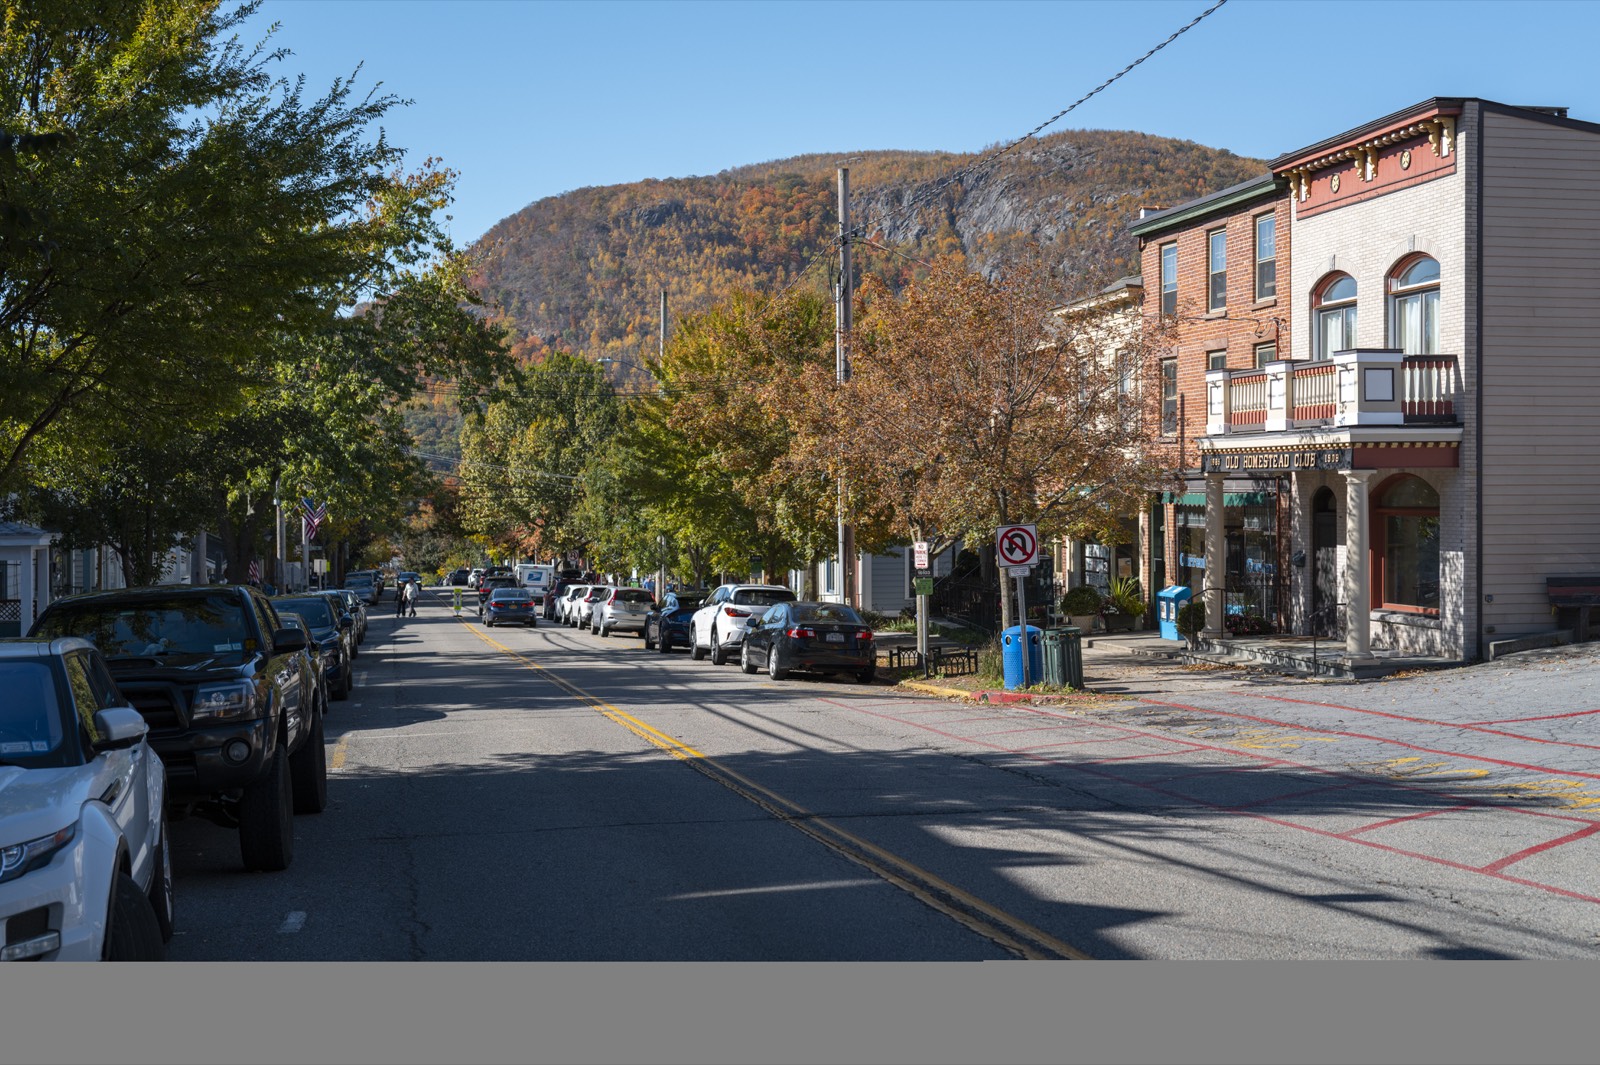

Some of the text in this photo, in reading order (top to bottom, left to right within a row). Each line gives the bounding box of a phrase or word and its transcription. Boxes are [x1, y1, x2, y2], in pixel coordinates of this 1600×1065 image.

[1225, 455, 1240, 469] OLD
[1243, 452, 1290, 469] HOMESTEAD
[1293, 453, 1316, 467] CLUB
